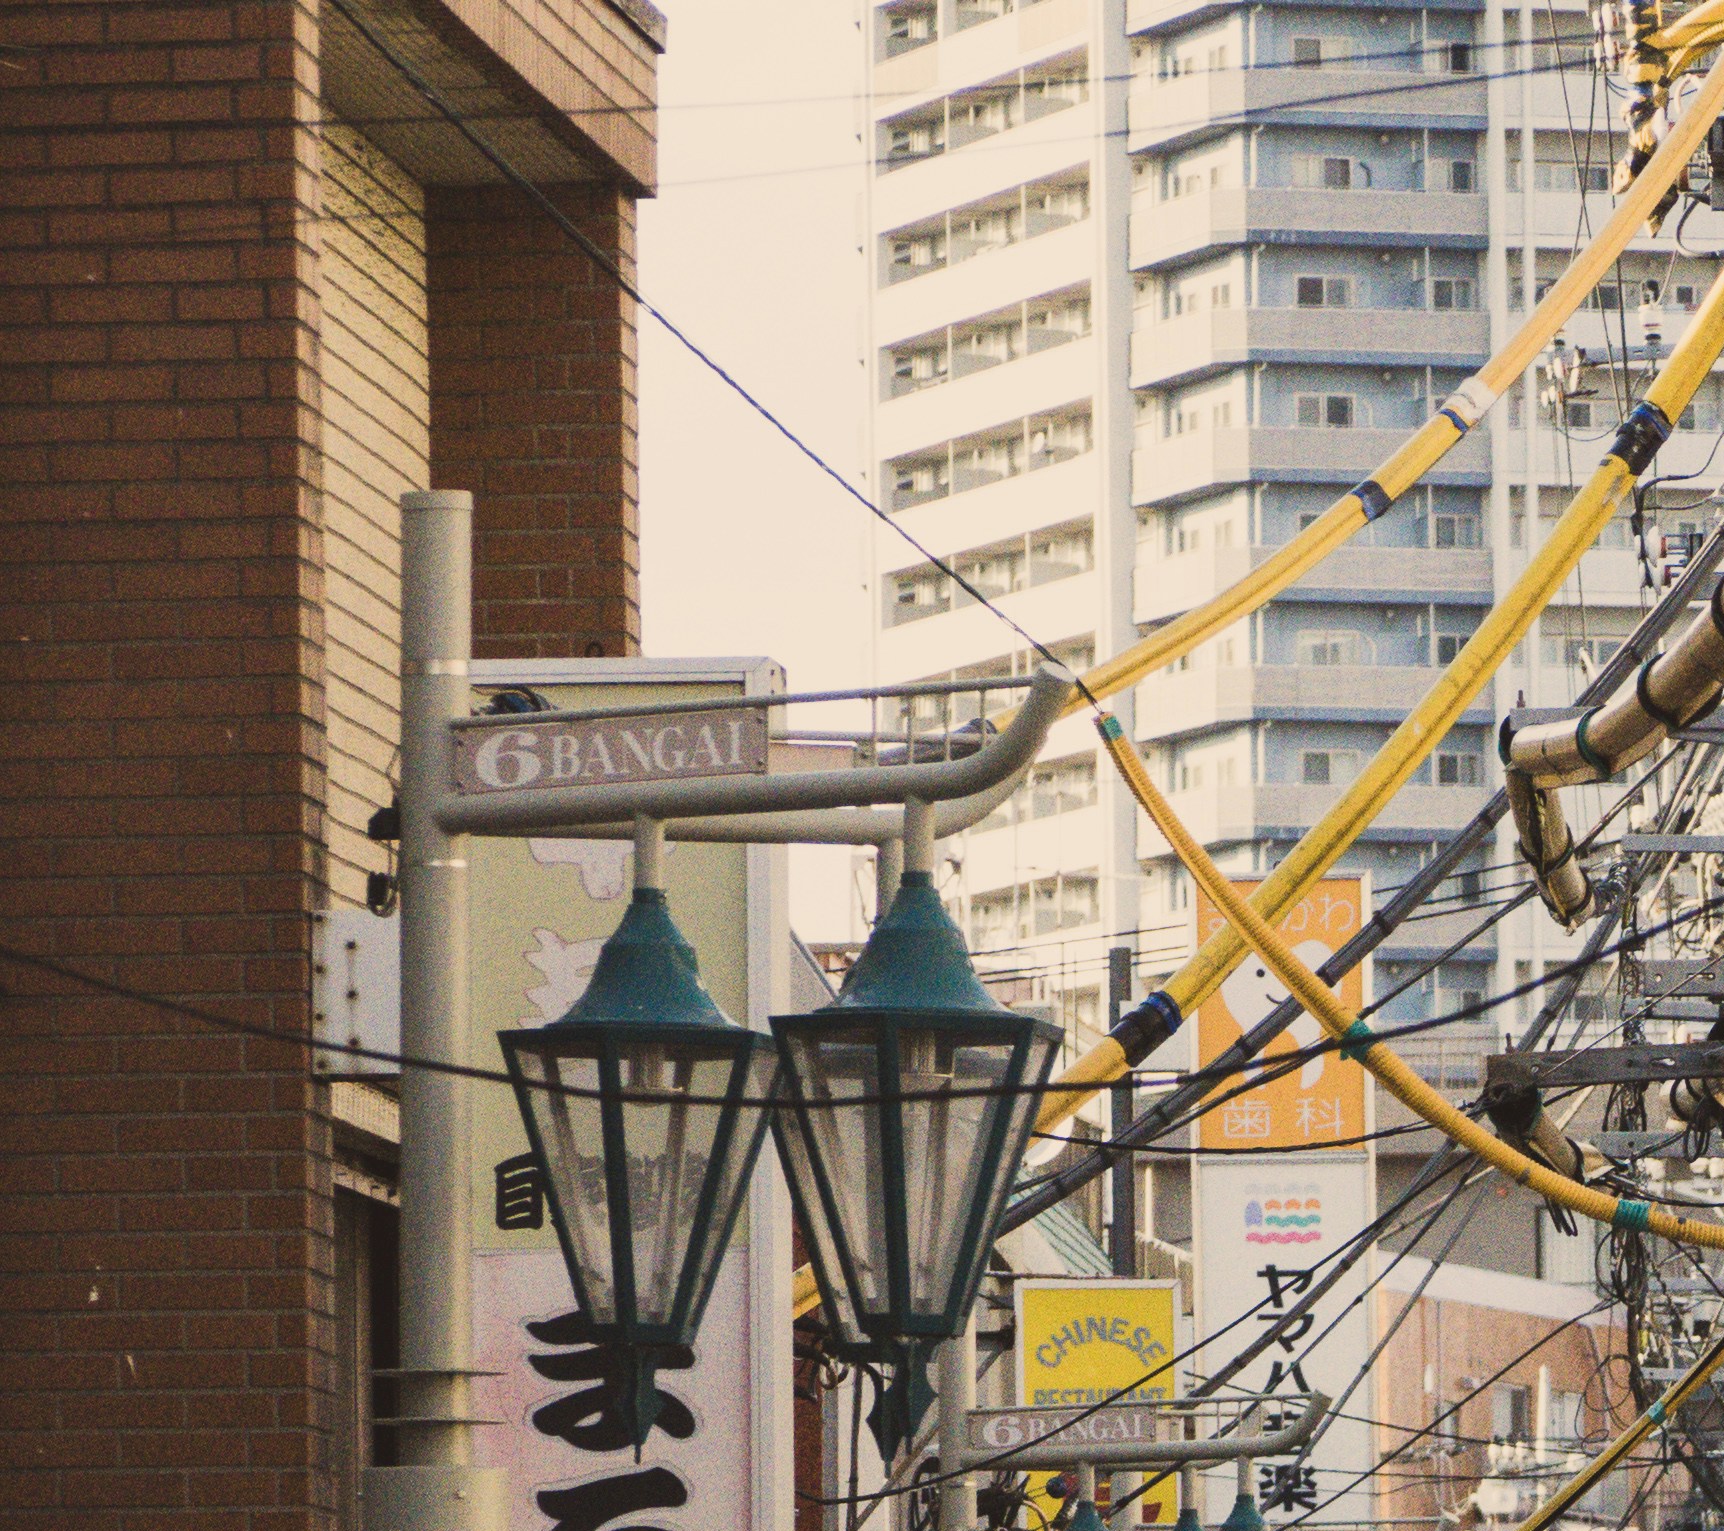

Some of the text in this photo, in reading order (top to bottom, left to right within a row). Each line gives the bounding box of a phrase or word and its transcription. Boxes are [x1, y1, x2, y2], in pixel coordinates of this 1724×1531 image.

[550, 722, 747, 778] BANGAI
[1222, 1098, 1346, 1138] 歯科
[1036, 1316, 1167, 1368] CHINESE
